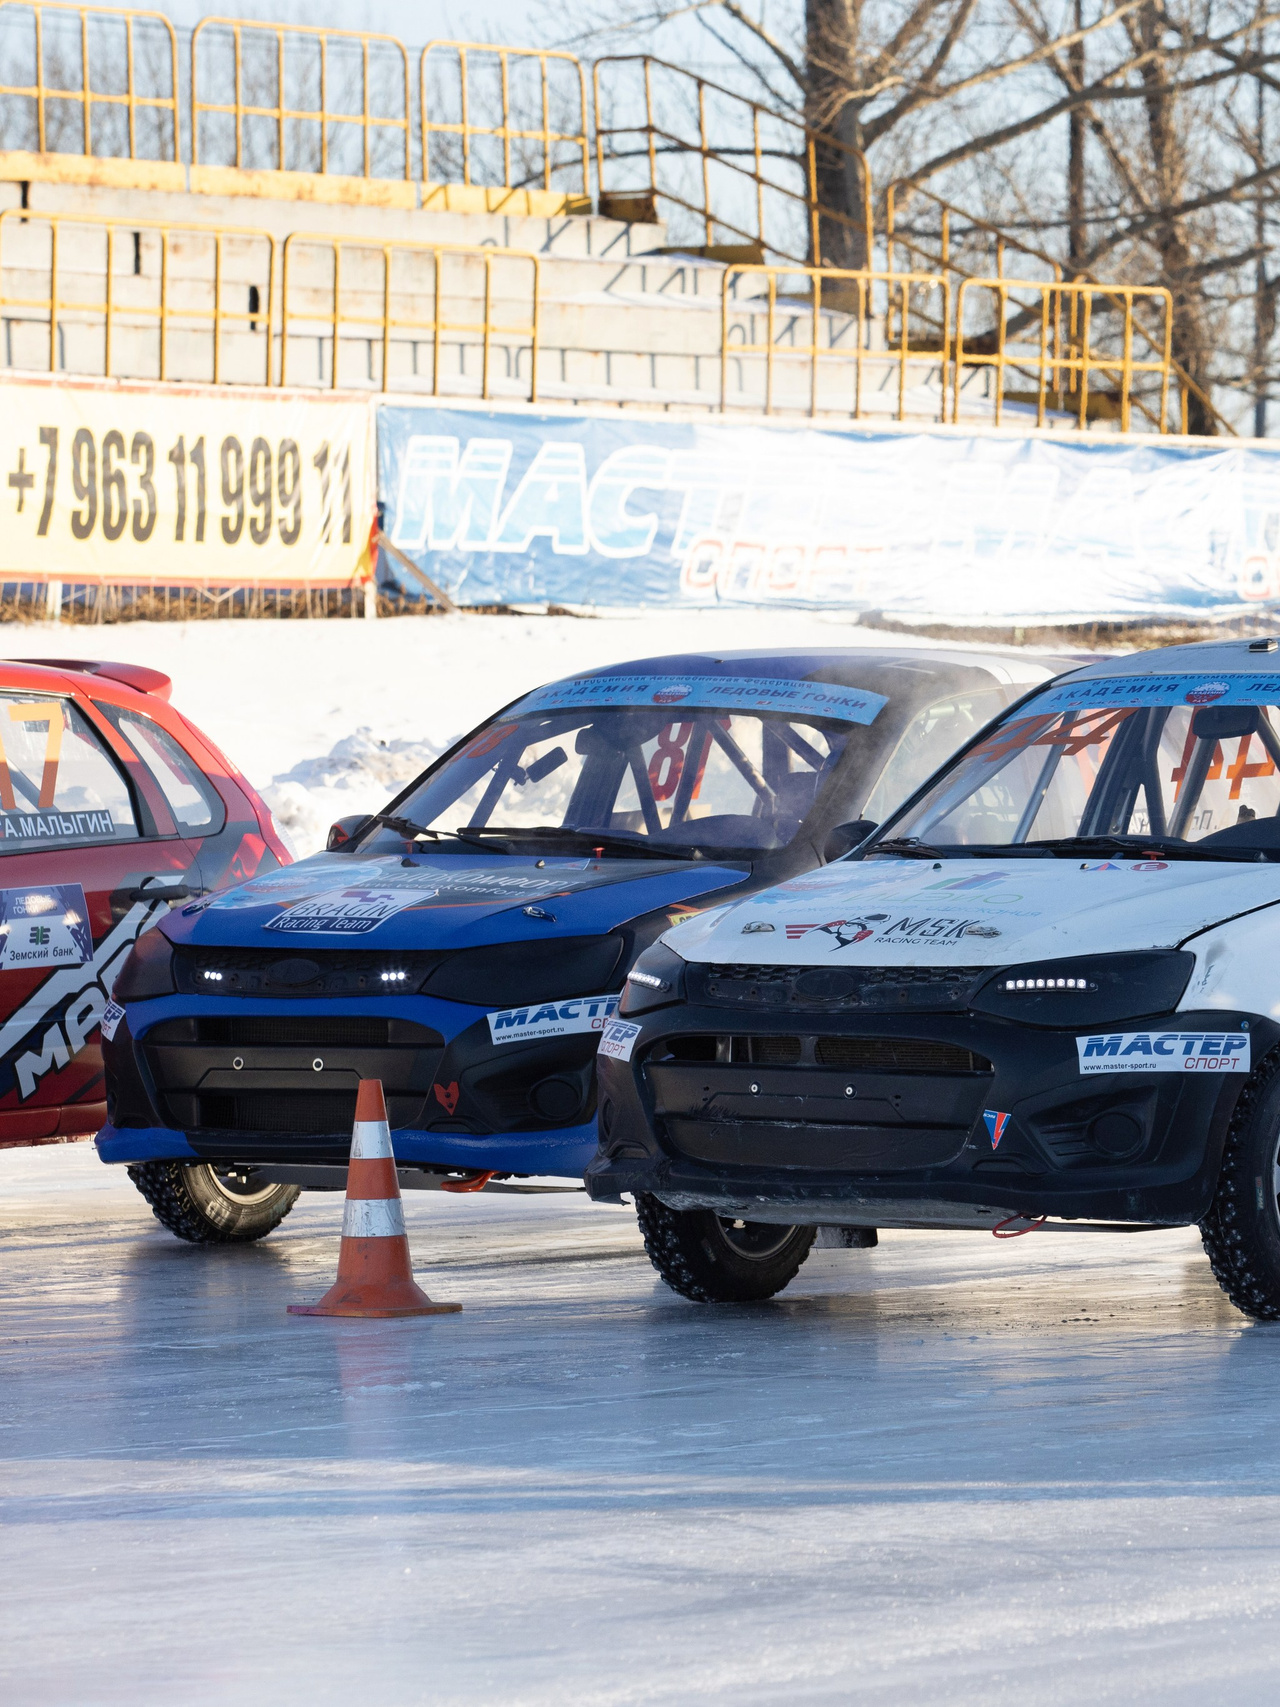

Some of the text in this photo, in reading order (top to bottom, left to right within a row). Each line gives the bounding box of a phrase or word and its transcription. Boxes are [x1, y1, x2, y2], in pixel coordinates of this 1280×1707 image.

[8, 426, 353, 545] +7 963 11 999 11
[538, 684, 868, 710] АКАДЕМИЯ ЛЕДОВЫЕ ГОНКИ
[1051, 683, 1180, 701] АКАДЕМИЯ
[5, 812, 114, 838] А.МАЛЫГИН
[276, 917, 372, 931] Racing Team
[874, 936, 958, 947] RACING TEAM
[9, 946, 74, 962] Земский банк
[494, 995, 620, 1031] МАСТ
[495, 1026, 565, 1042] www.master-sport.ru
[1083, 1034, 1248, 1058] МАСТЕР
[1084, 1062, 1157, 1072] www.master-sport.ru
[1184, 1057, 1240, 1070] СПОРТ
